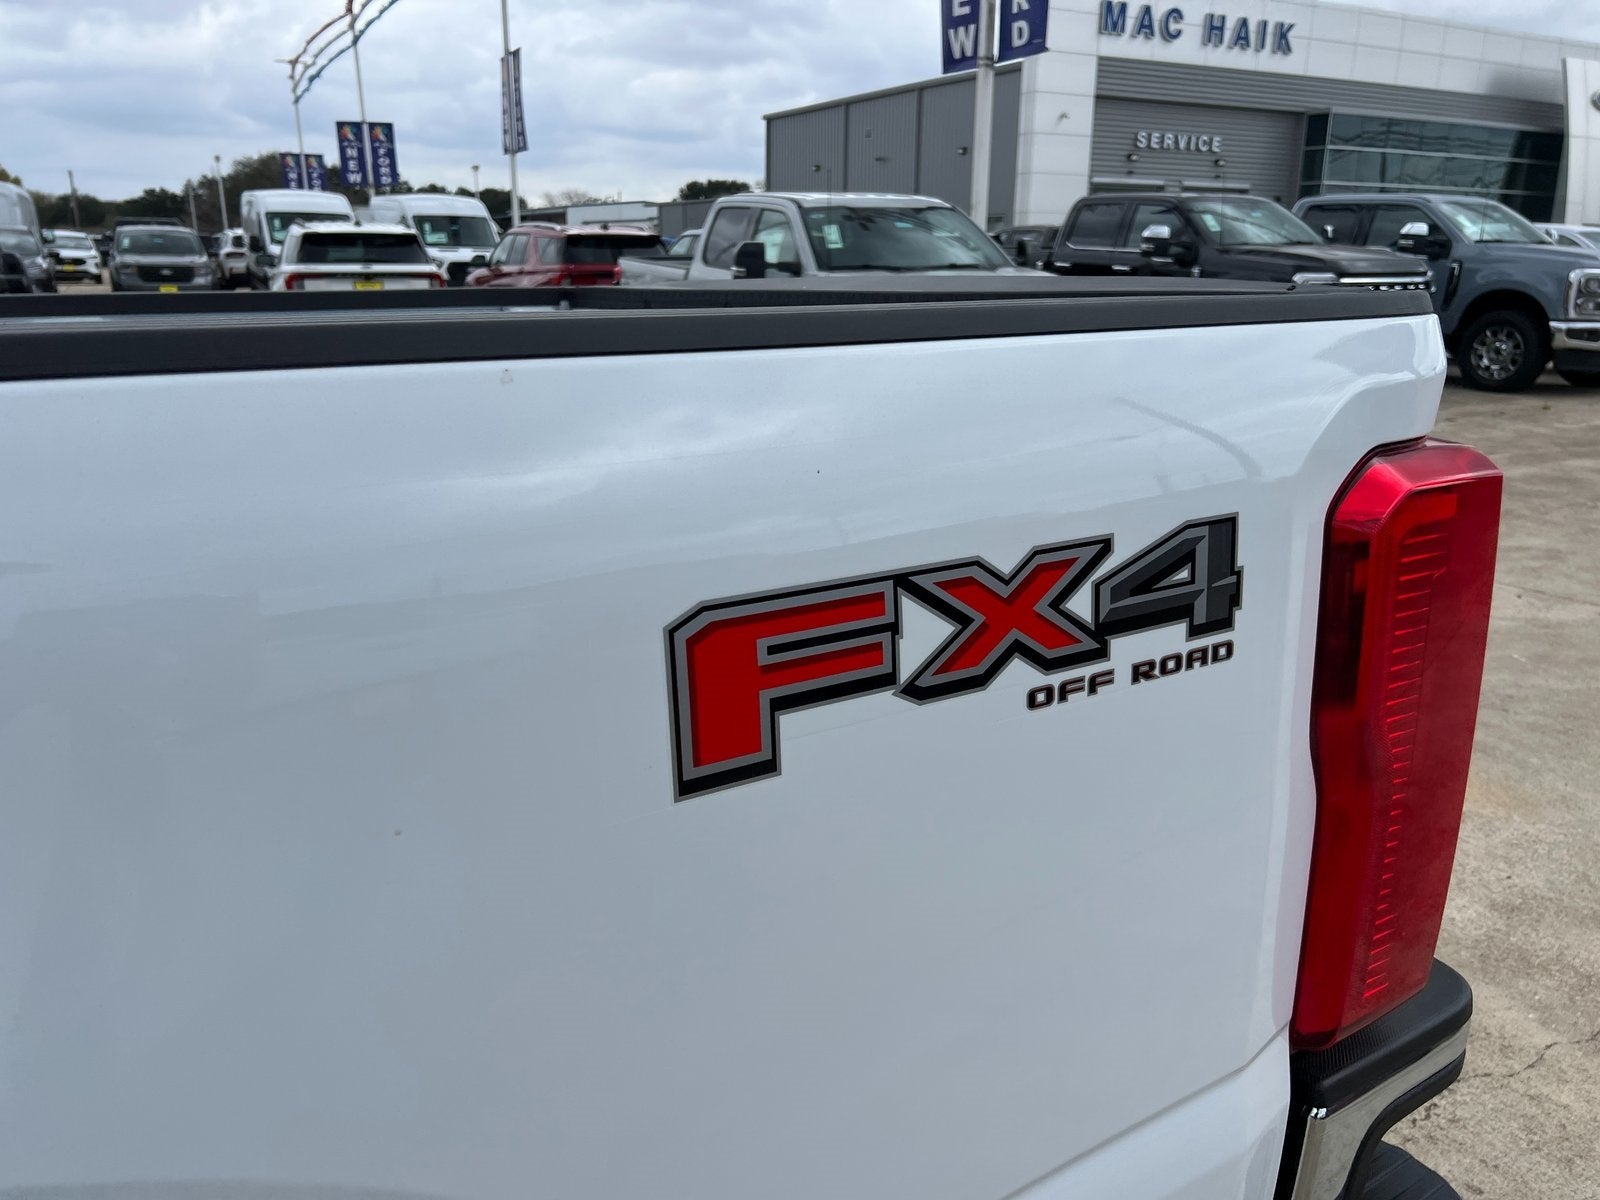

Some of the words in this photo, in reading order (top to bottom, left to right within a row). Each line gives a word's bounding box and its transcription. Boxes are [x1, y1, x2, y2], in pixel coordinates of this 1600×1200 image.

[1100, 0, 1185, 42] MAC
[1203, 13, 1295, 55] HAIK
[344, 147, 363, 184] NEW
[1136, 130, 1224, 152] SERVICE
[663, 512, 1243, 803] FX4
[1026, 668, 1114, 711] OFF
[1131, 639, 1234, 684] ROAD
